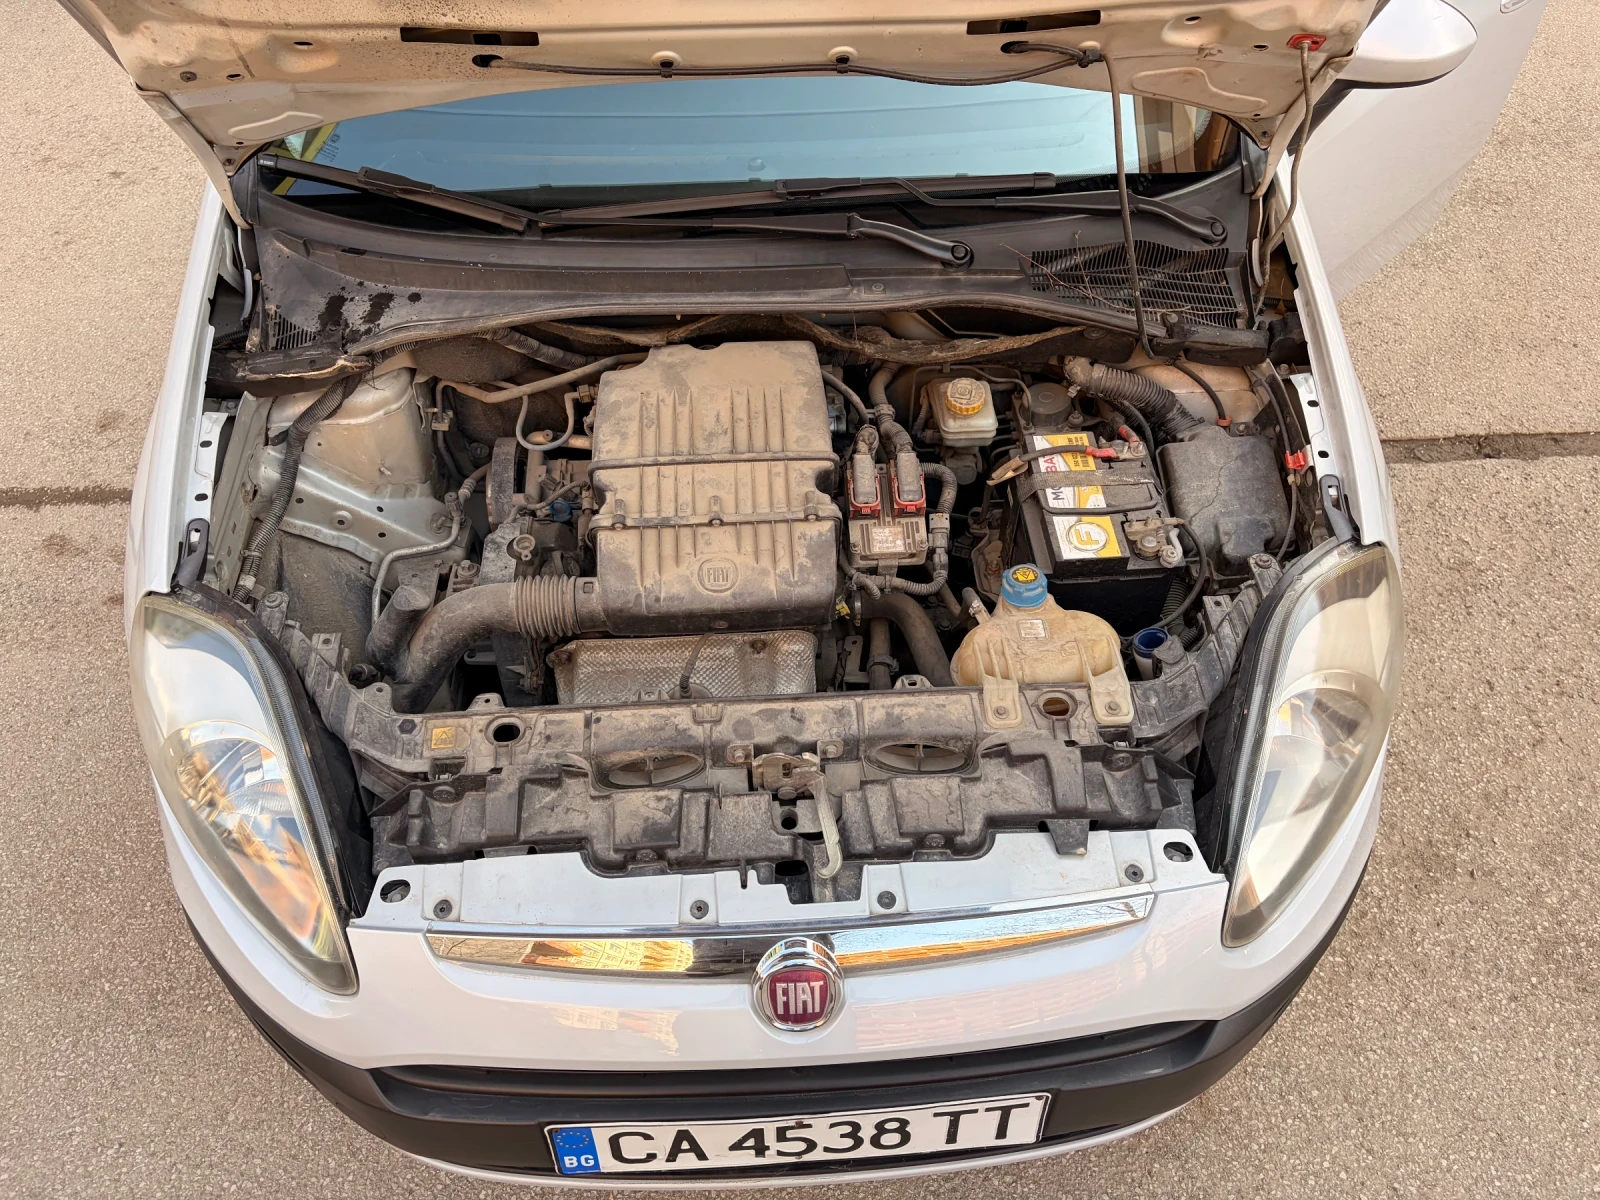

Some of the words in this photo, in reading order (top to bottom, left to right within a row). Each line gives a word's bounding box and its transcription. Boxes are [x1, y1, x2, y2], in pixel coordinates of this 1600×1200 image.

[707, 567, 730, 582] FIAT
[776, 981, 823, 1014] FIAT
[608, 1129, 709, 1164] CA
[728, 1117, 911, 1158] 4538
[933, 1102, 1030, 1144] TT
[564, 1155, 595, 1168] BG
